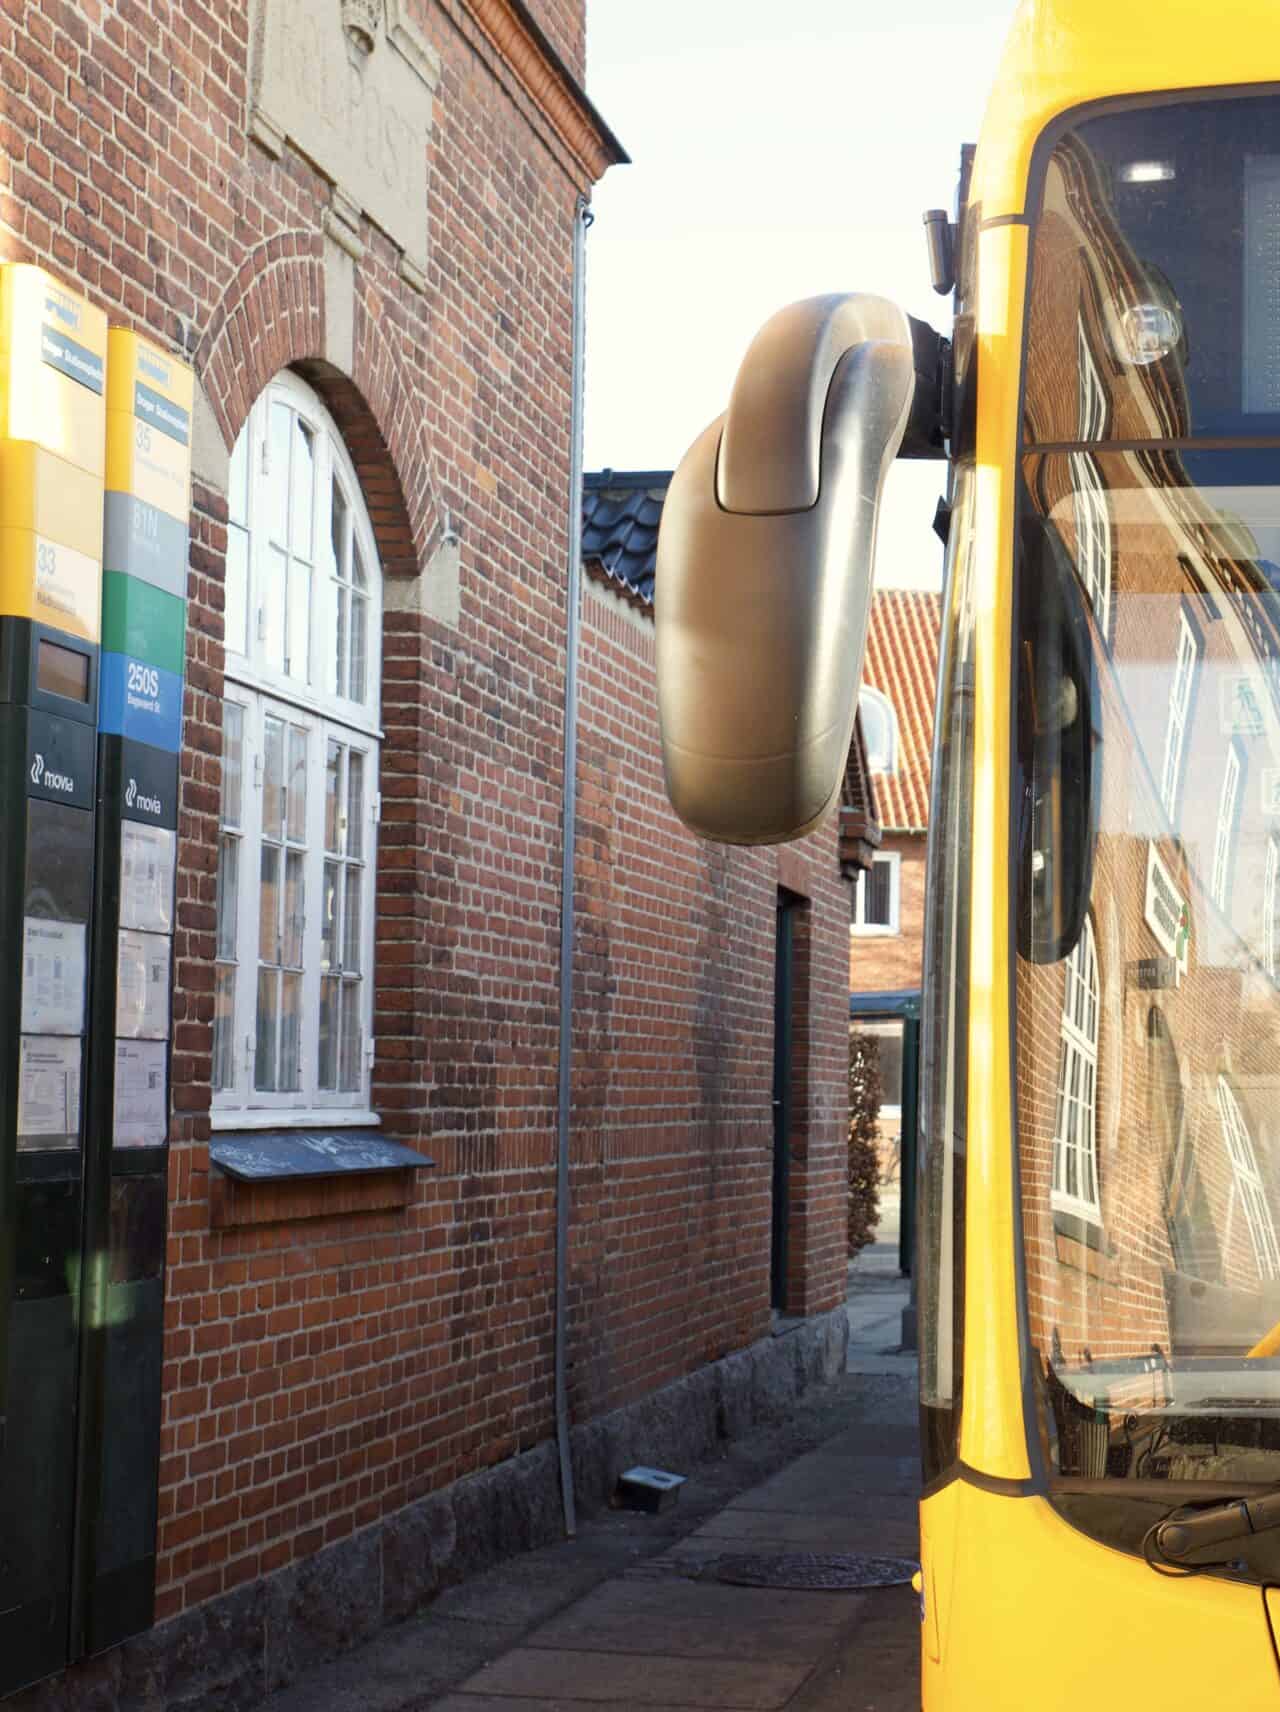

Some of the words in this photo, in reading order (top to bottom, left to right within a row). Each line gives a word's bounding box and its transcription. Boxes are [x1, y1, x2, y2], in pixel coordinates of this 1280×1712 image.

[128, 662, 159, 698] 250S
[44, 770, 74, 793] movia
[136, 794, 161, 814] movia
